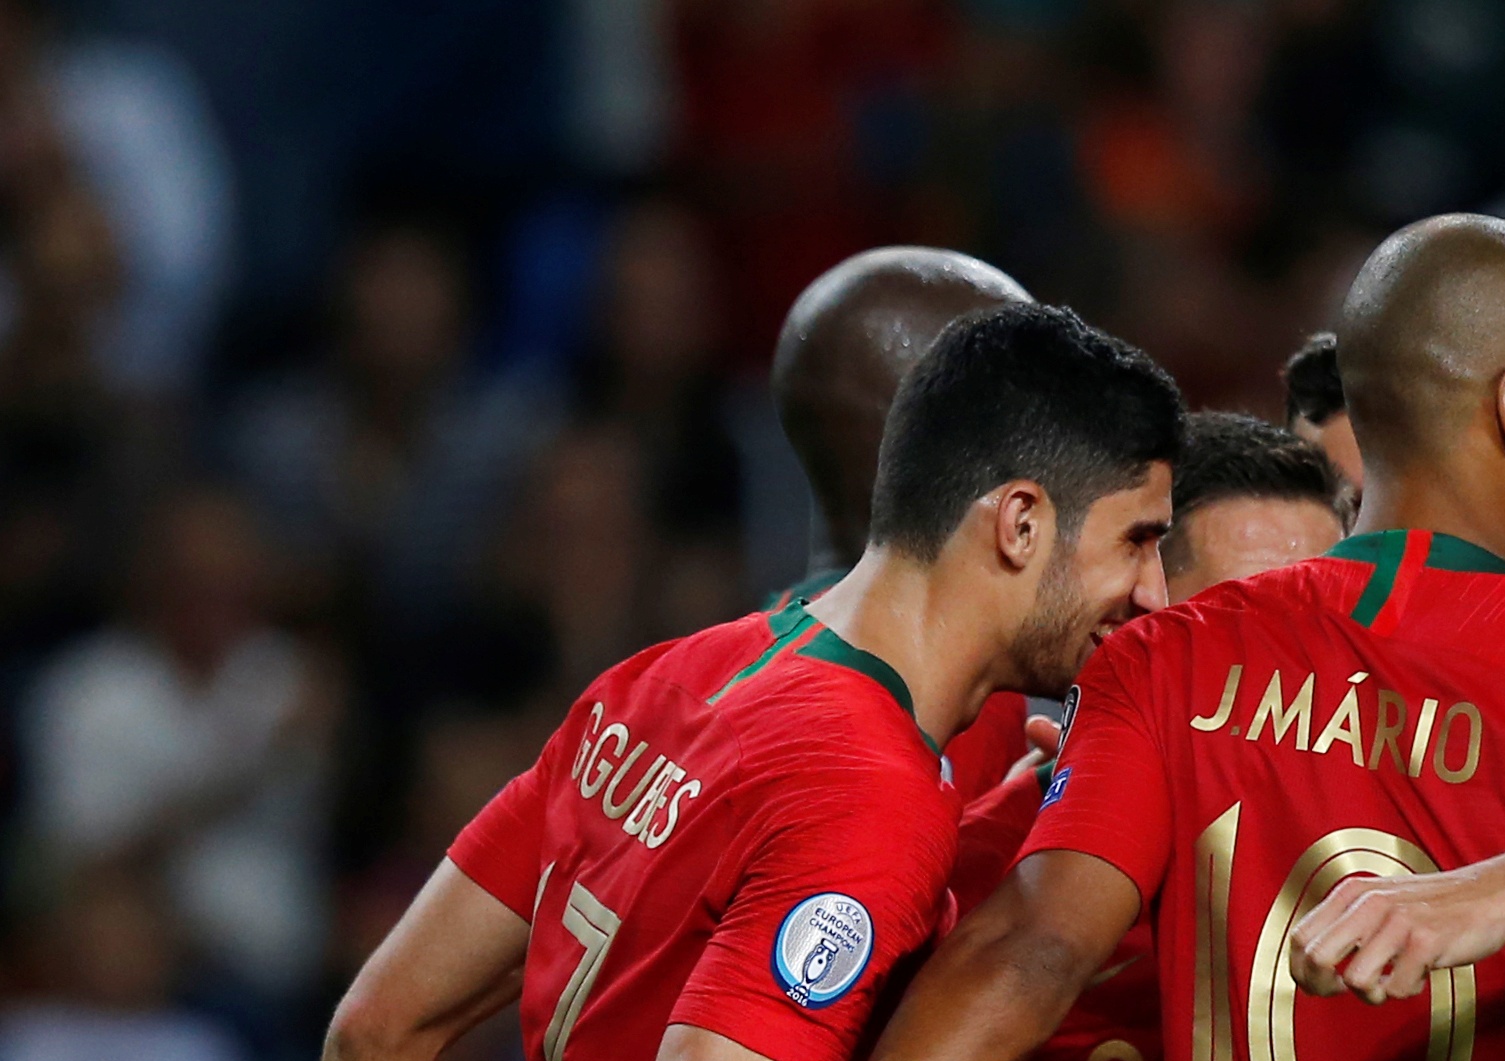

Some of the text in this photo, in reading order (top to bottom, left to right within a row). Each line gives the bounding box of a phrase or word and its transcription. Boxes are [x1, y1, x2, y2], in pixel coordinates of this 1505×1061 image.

[1190, 664, 1483, 784] J.MÁRIO
[815, 907, 864, 945] EUROPEAN
[835, 902, 863, 926] UEFA
[809, 917, 856, 954] CHAMPIONS
[786, 988, 808, 1007] 2016
